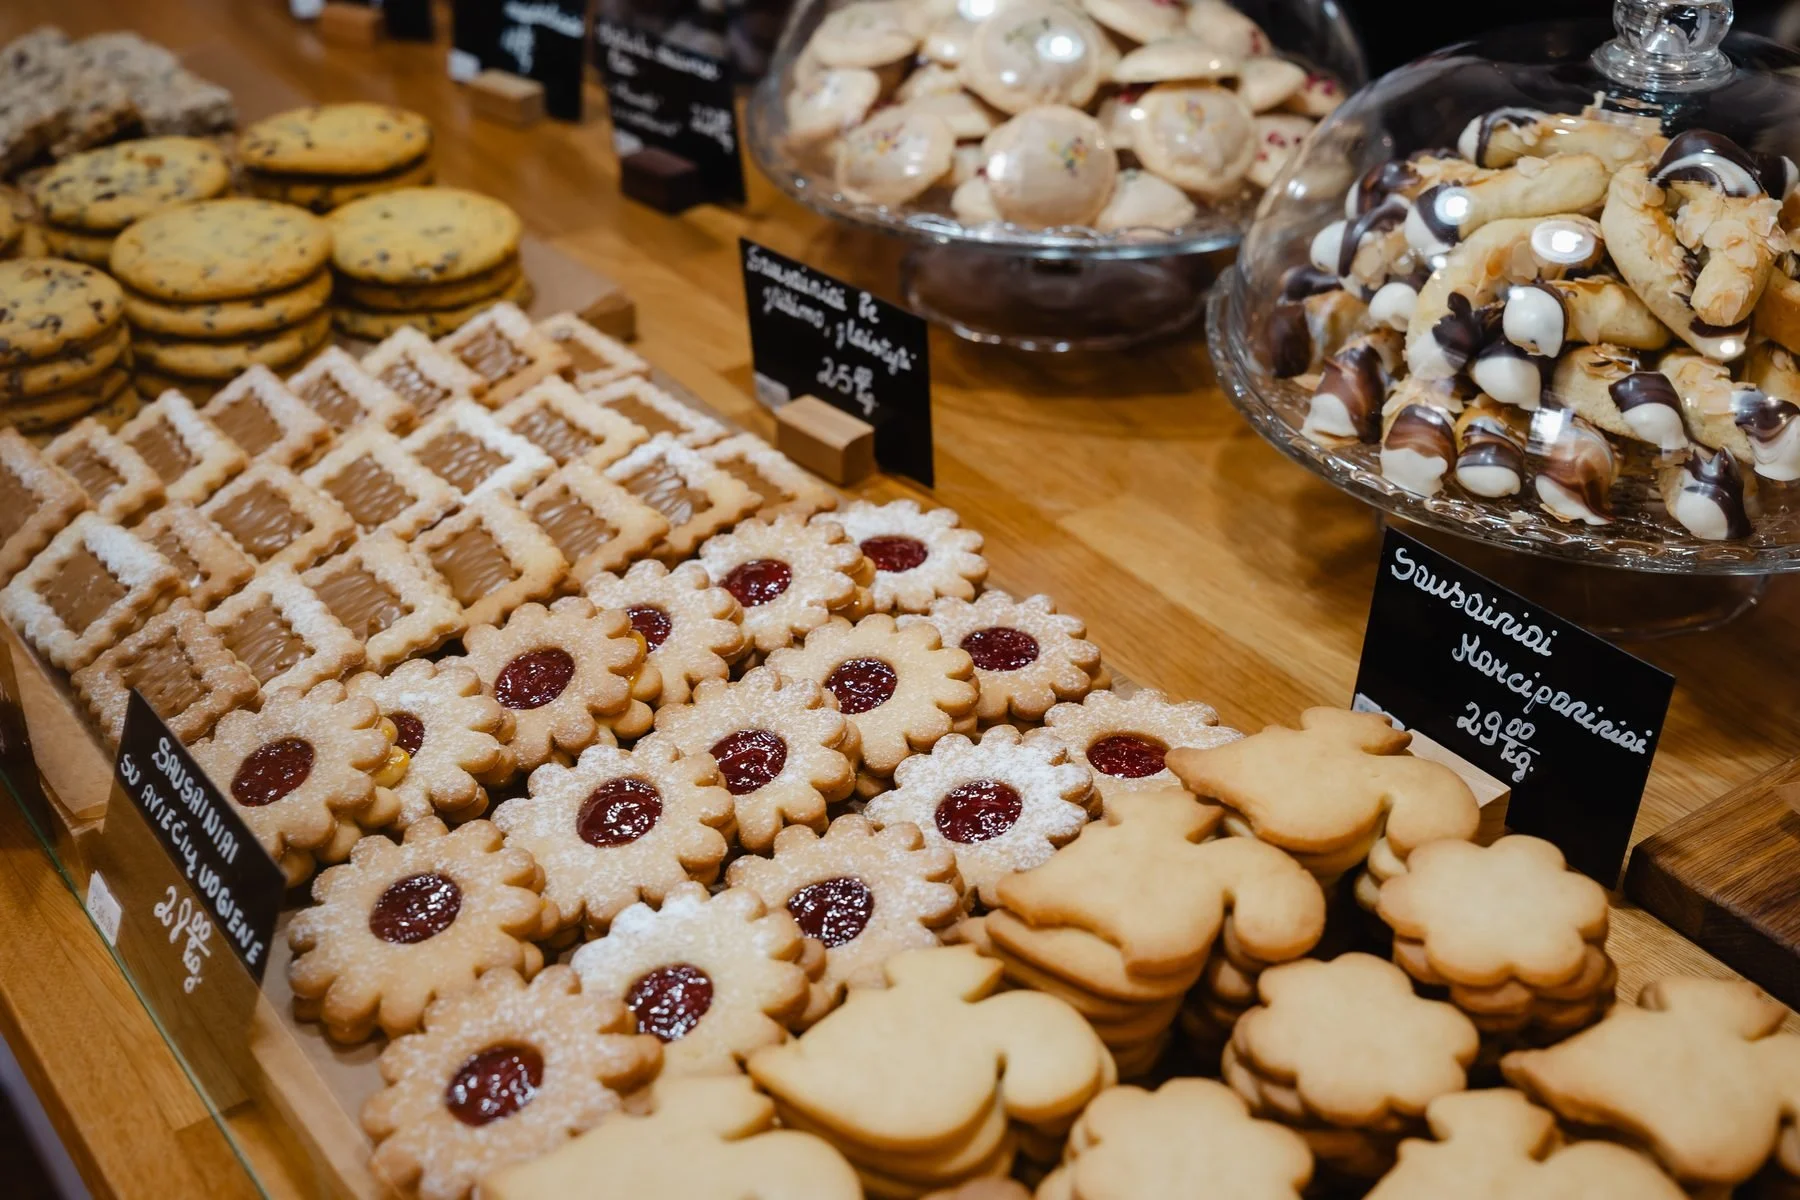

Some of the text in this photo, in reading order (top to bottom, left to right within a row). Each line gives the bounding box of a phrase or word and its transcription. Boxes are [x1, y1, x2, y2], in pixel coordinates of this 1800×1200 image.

[1391, 547, 1558, 656] Sausainiai
[1452, 633, 1653, 754] Marcipaniniai
[120, 753, 141, 786] SU
[198, 863, 264, 965] UOGIENE
[152, 737, 240, 865] SAUSAINIAI
